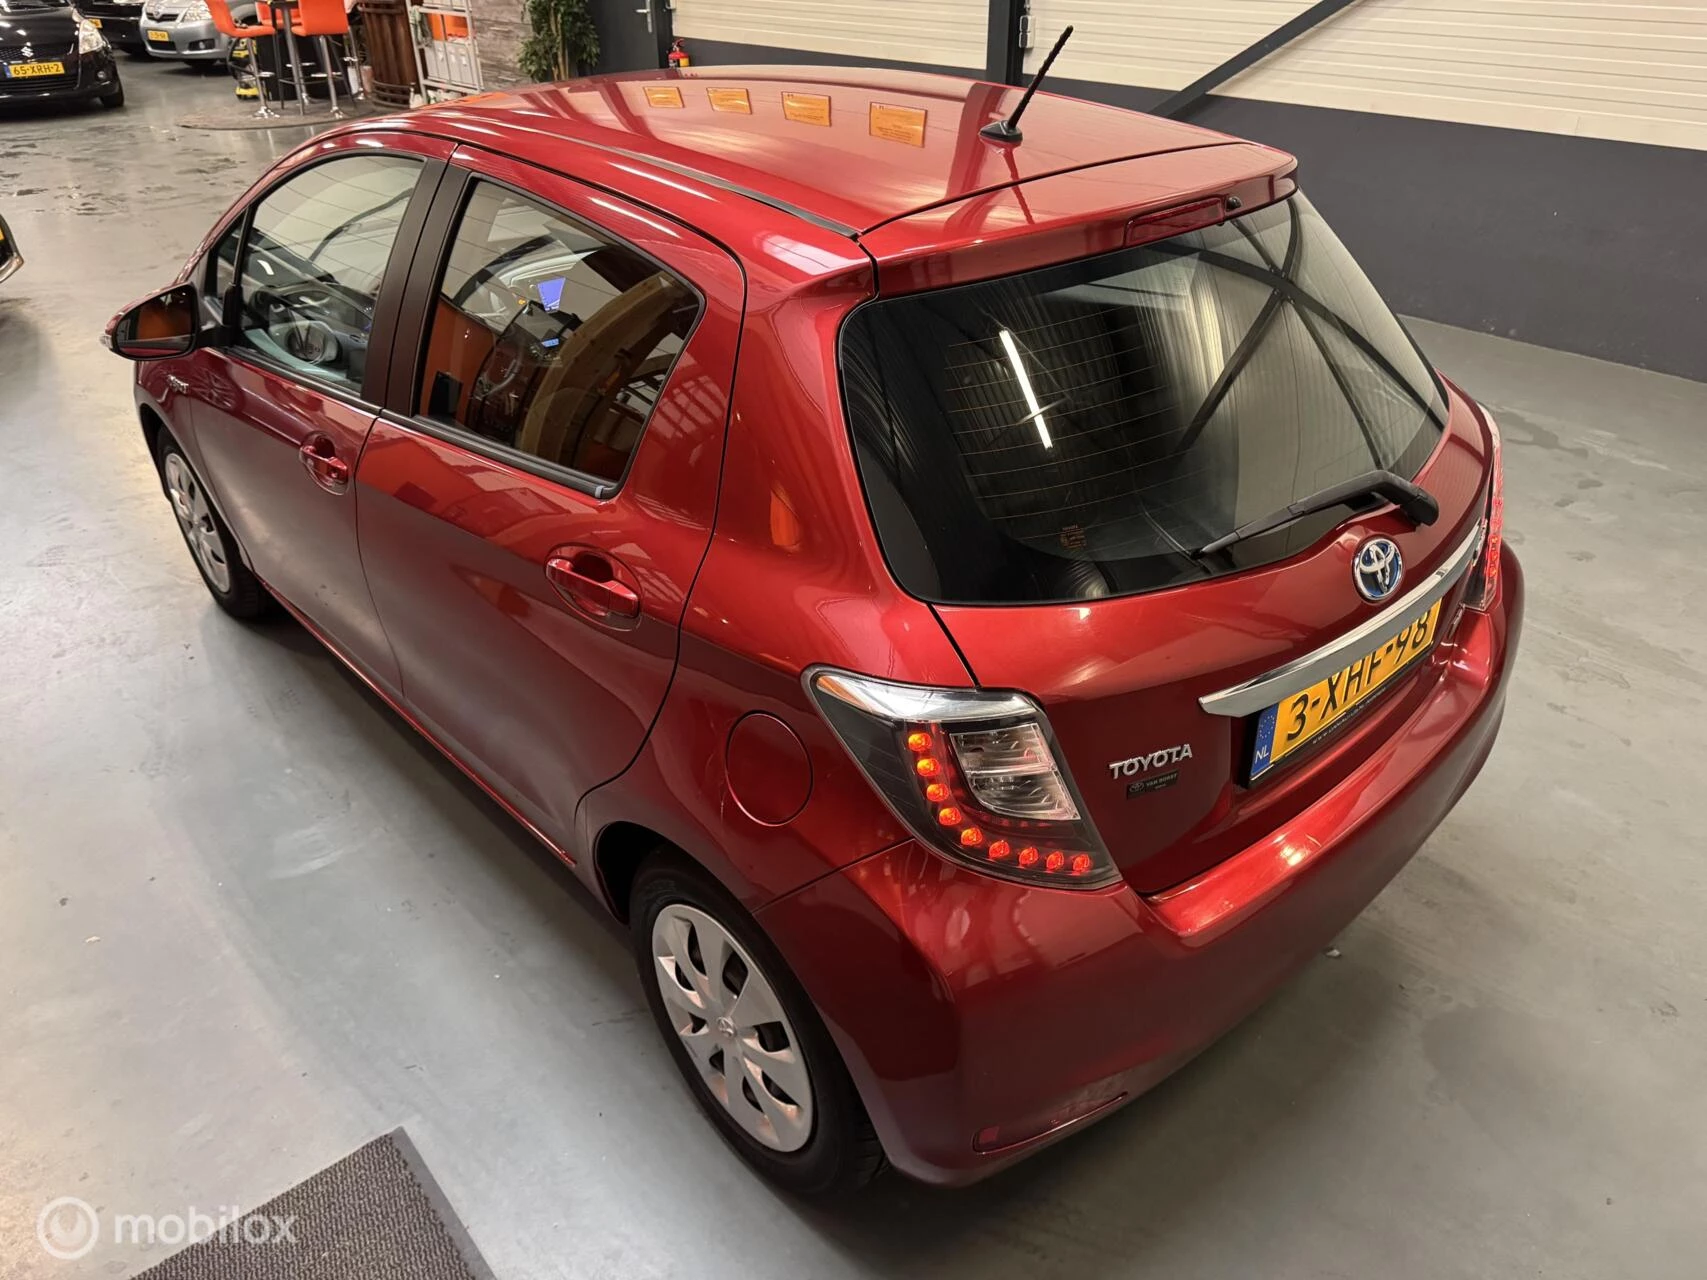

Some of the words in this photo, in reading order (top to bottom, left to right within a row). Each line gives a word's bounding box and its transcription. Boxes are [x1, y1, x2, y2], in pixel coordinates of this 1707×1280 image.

[13, 63, 61, 76] 65-XRH-2
[1286, 609, 1432, 742] 3-XHF-98
[1109, 743, 1193, 779] TOYOTA
[1254, 744, 1270, 764] NL
